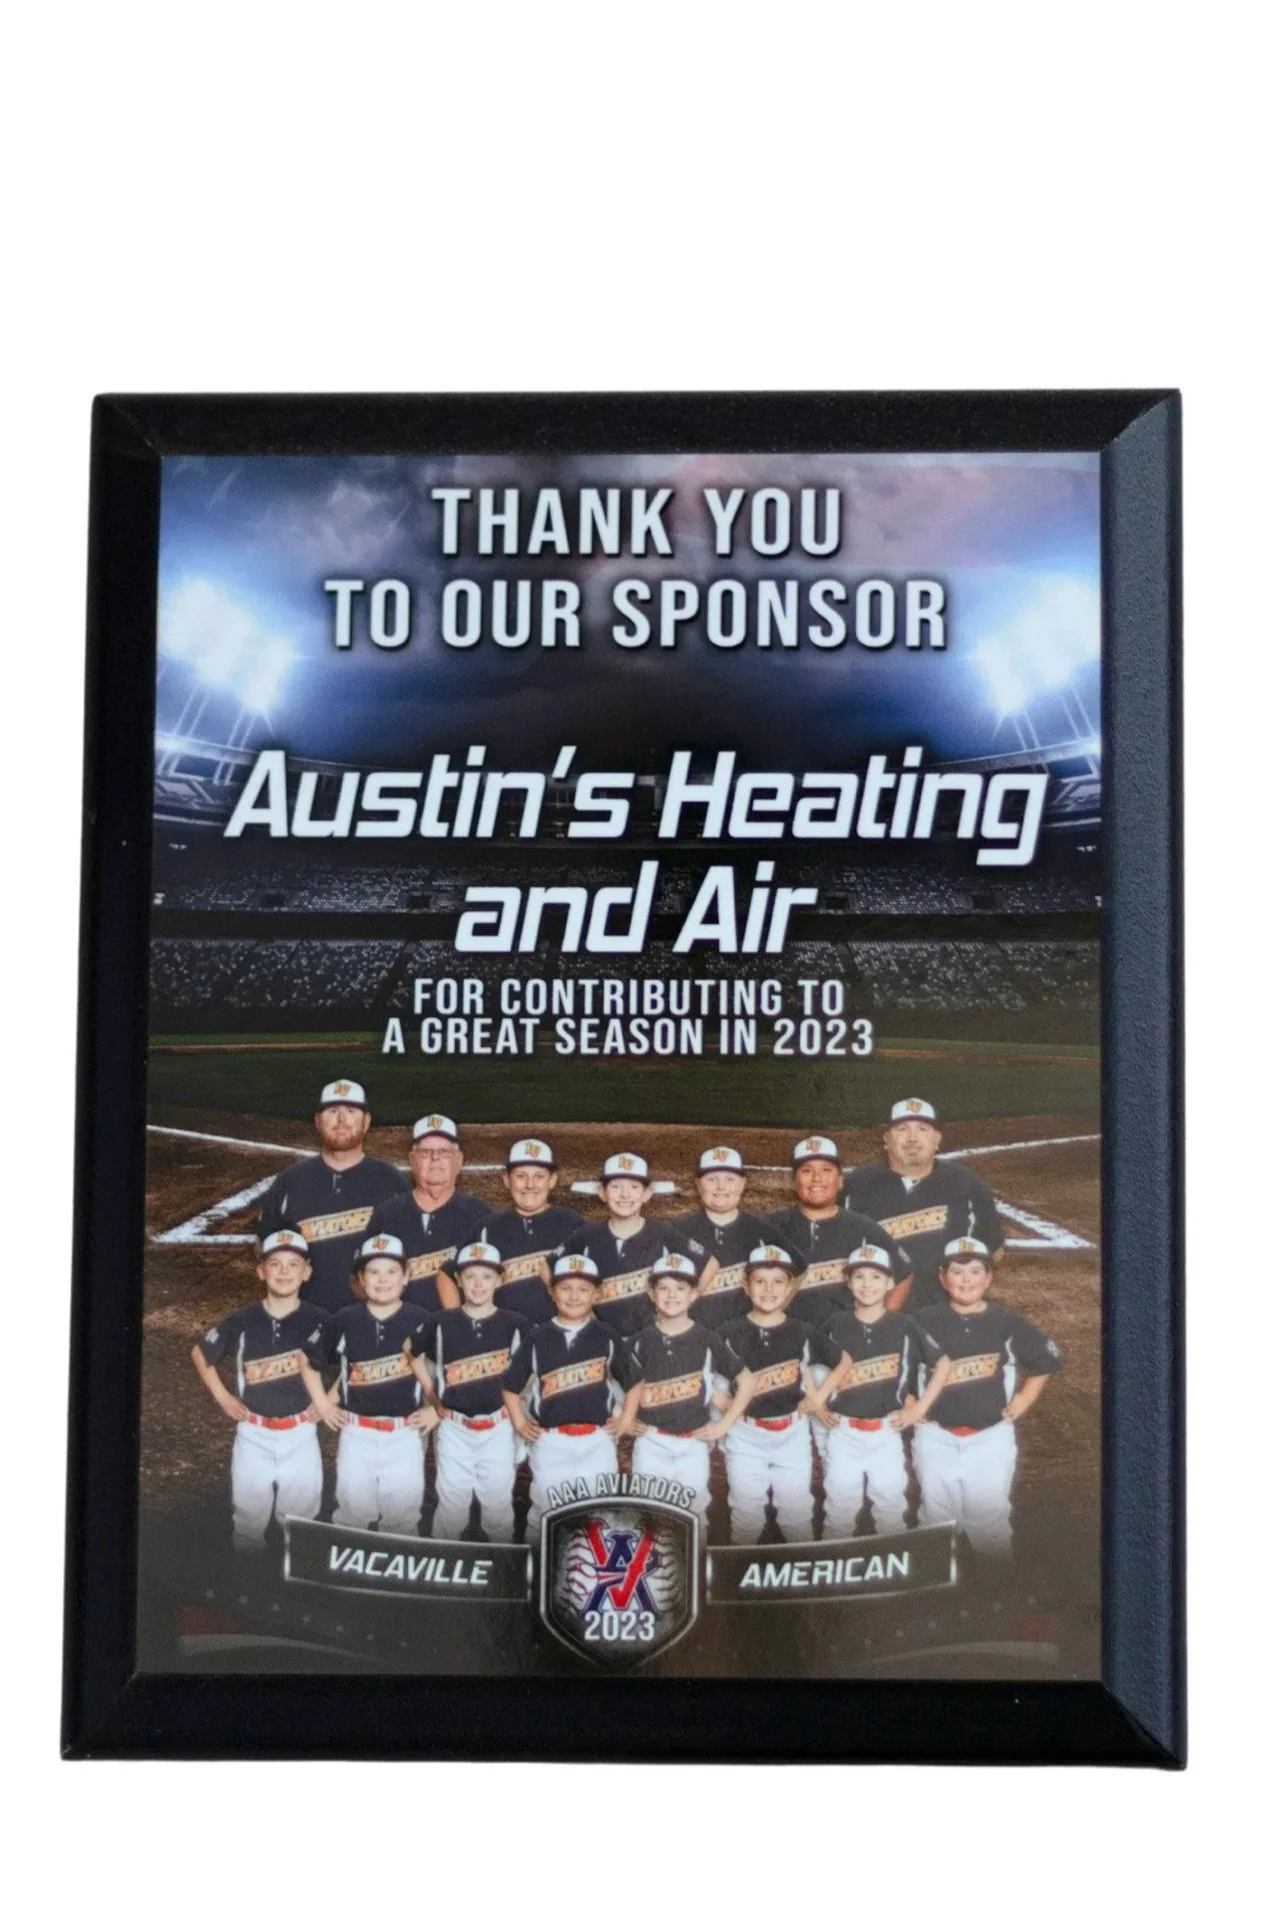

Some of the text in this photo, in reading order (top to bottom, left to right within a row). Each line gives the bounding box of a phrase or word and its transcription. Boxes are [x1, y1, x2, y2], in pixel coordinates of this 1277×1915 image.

[432, 488, 843, 555] THANK YOU
[325, 579, 948, 649] TO OUR SPONSOR
[224, 744, 1049, 867] Austin's Heating
[454, 859, 819, 954] and Air
[414, 978, 844, 1016] FOR CONTRIBUTING TO
[382, 1018, 873, 1056] A GREAT SEASON IN 2023
[547, 1473, 696, 1509] AAA AVIATORS
[328, 1546, 493, 1586] VACAVILLE
[739, 1551, 911, 1589] AMERICAN
[584, 1610, 656, 1642] 2023
